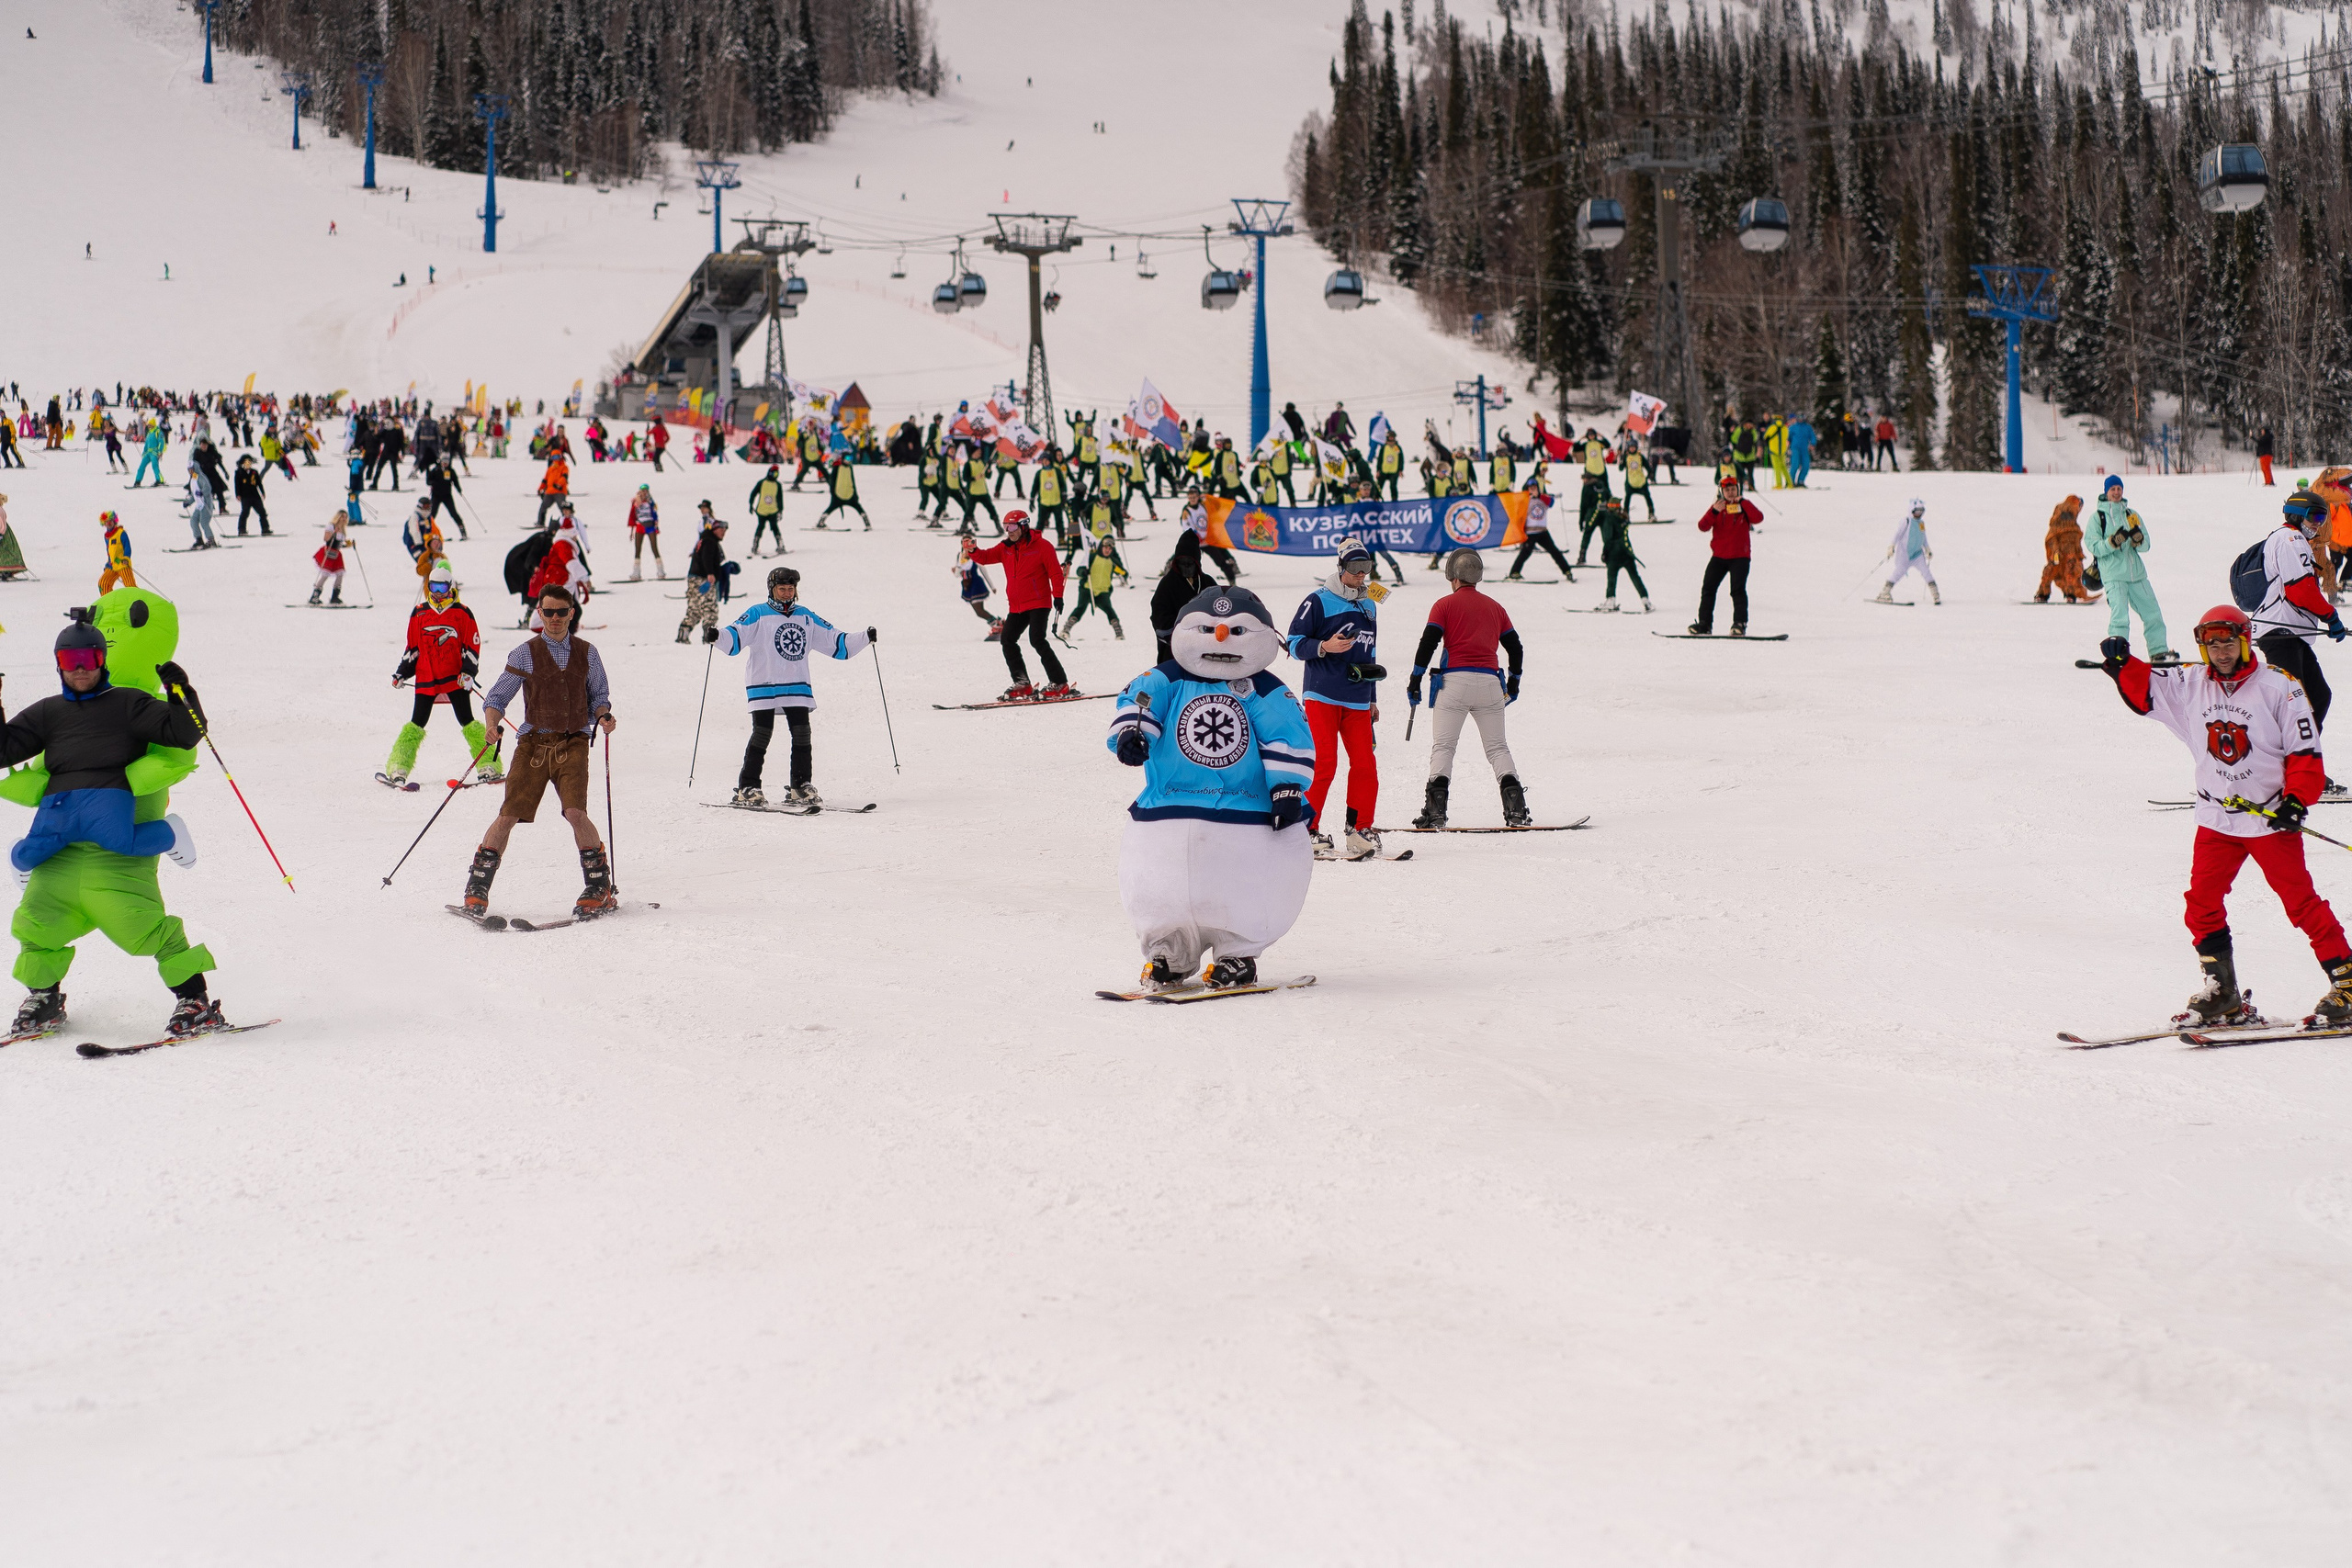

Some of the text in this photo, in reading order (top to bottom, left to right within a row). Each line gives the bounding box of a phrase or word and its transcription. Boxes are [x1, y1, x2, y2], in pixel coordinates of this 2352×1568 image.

[1288, 504, 1433, 533] КУЗБАССКИЙ
[1300, 601, 1312, 620] 7
[1179, 696, 1248, 728] ХОККЕЙНЫЙ КЛУБ СИБИРЬ
[2201, 704, 2253, 721] КУЗНЕЦКИЕ
[2297, 717, 2312, 740] 8
[1179, 735, 1249, 766] НОВОСИБИРСКАЯ ОБЛАСТЬ
